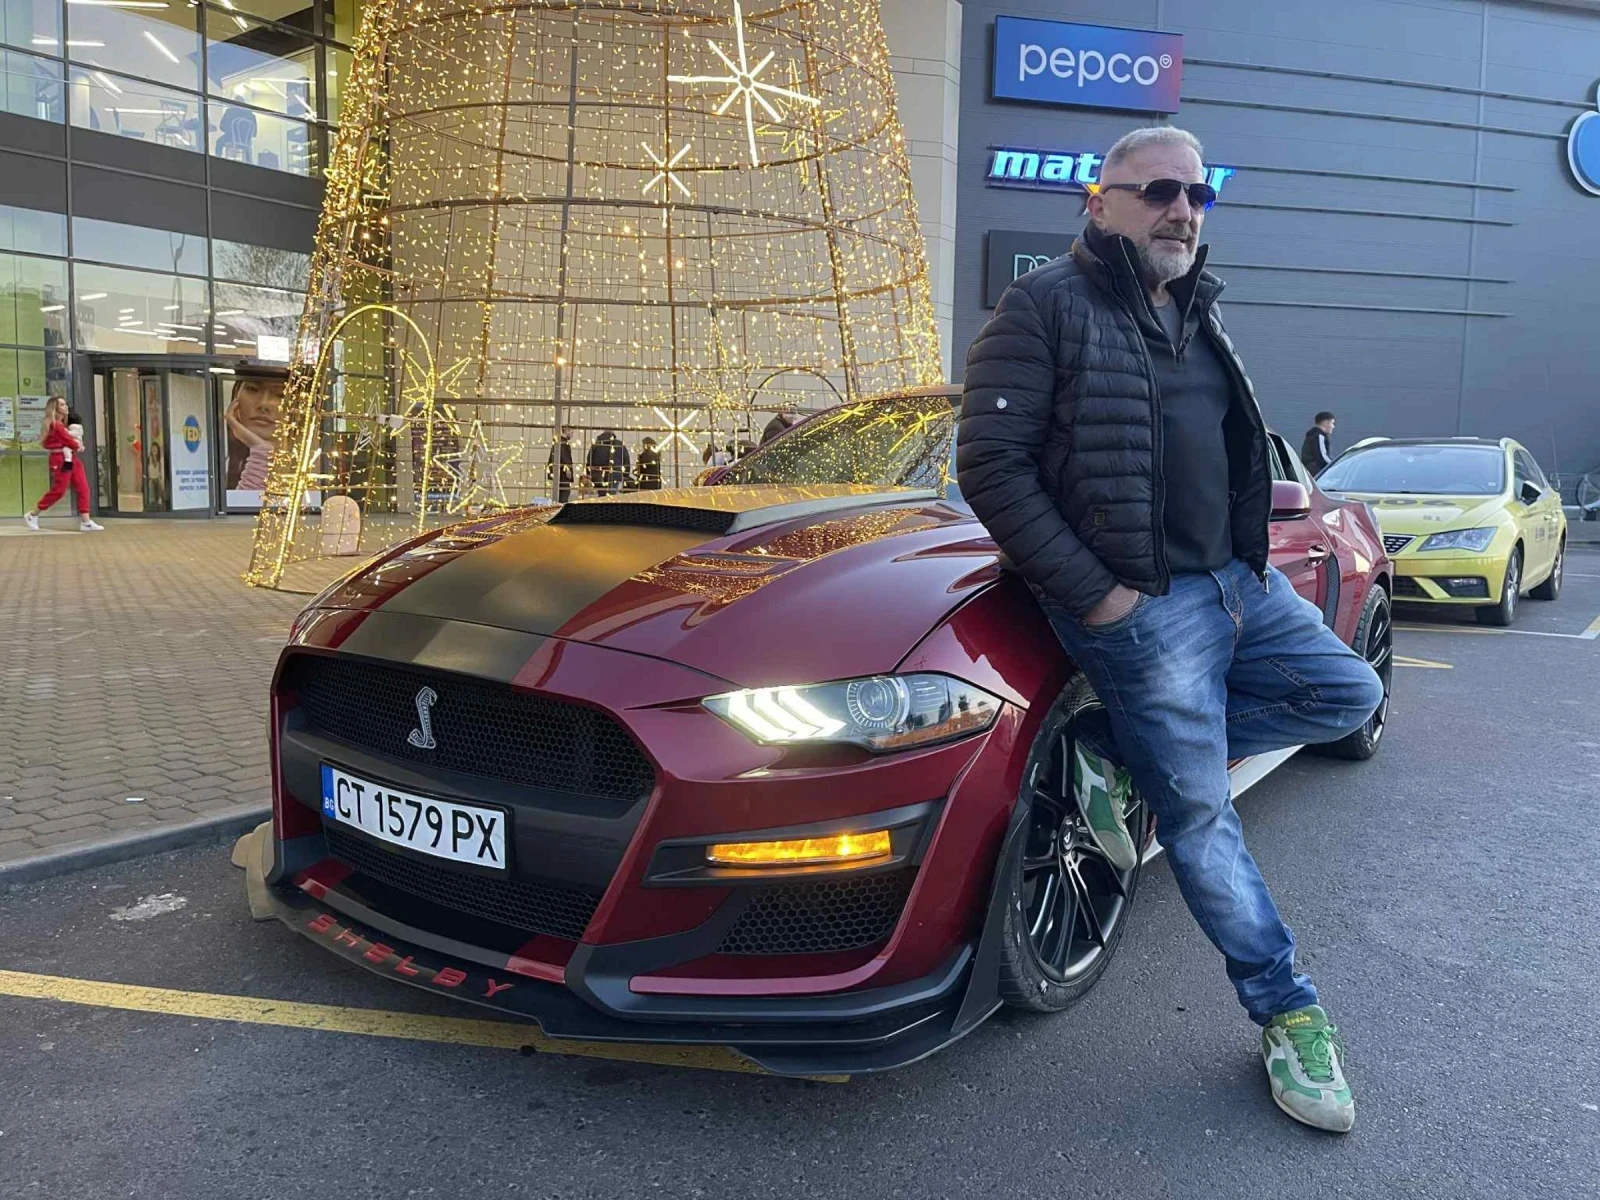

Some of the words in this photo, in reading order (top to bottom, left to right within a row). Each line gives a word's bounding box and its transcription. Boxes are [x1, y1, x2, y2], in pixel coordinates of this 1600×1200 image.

[1019, 43, 1160, 87] pepco
[324, 796, 335, 811] BG
[336, 777, 365, 824] CT
[374, 791, 444, 848] 1579
[451, 809, 498, 862] PX
[307, 913, 514, 998] SHELBY
